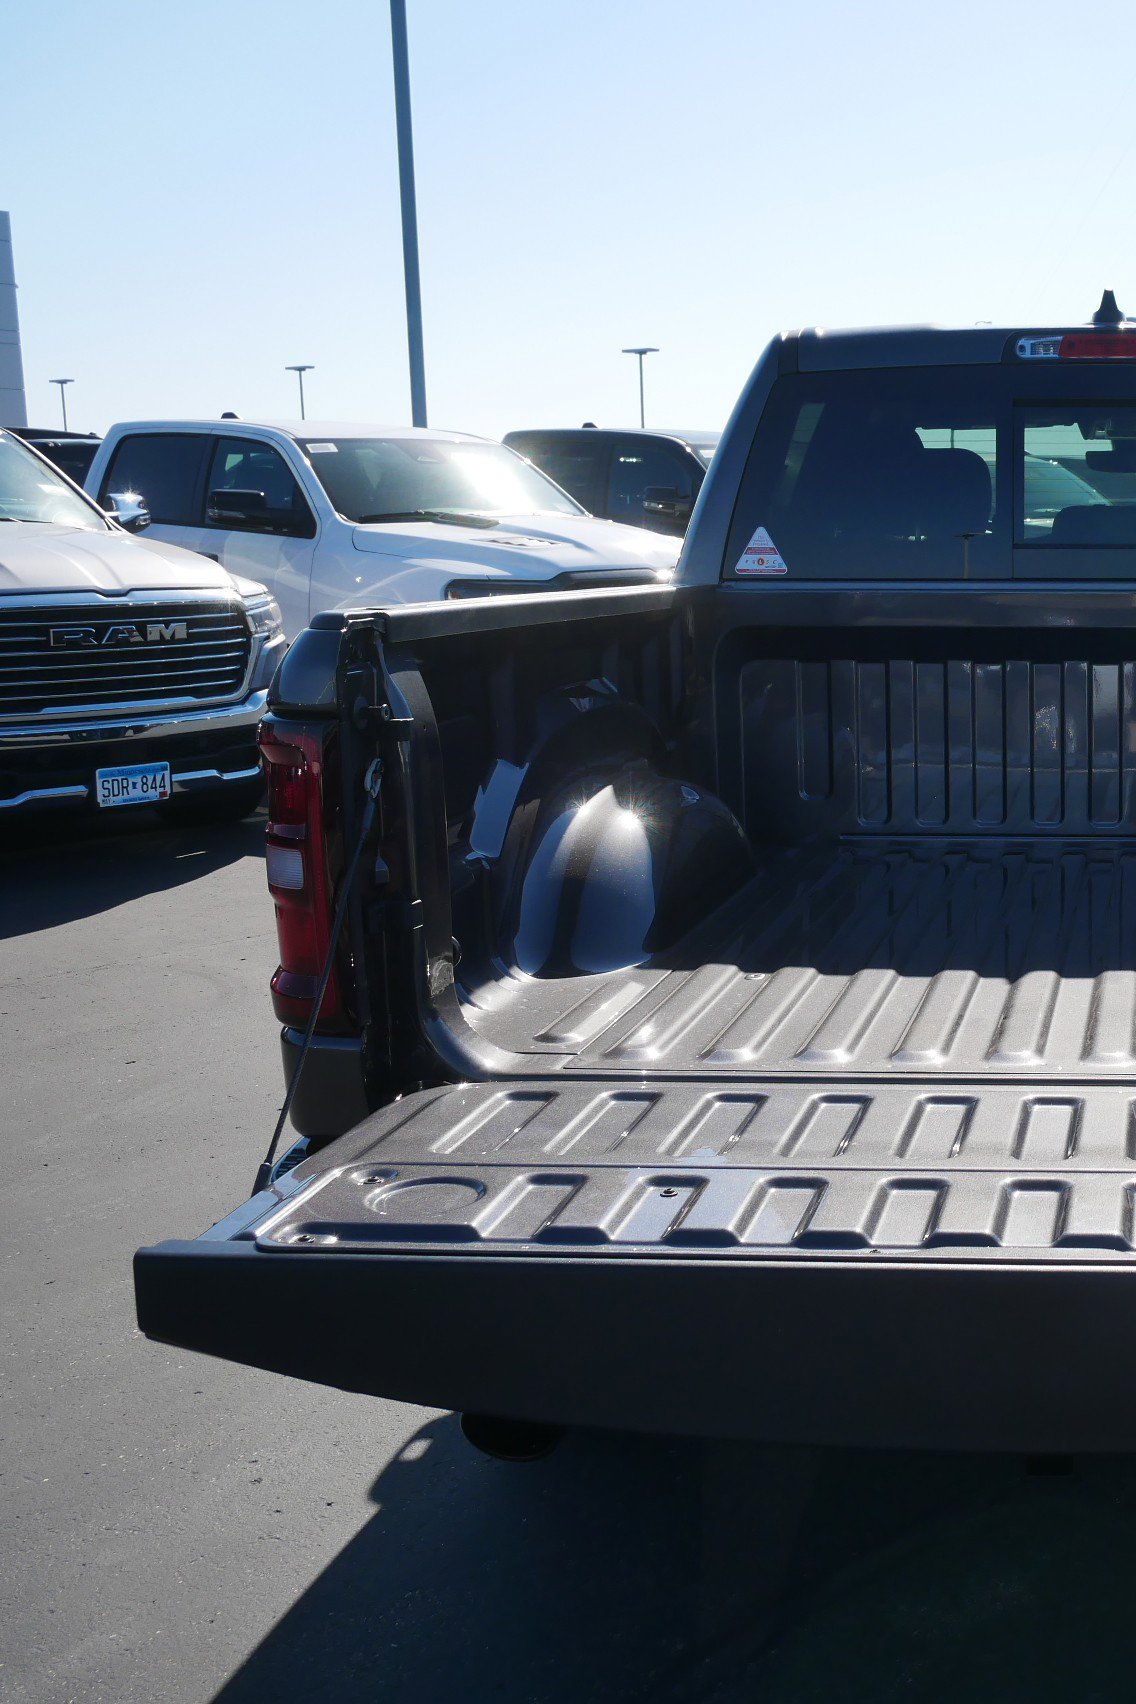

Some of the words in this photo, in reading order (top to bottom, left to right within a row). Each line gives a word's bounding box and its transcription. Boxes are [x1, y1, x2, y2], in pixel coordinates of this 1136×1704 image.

[49, 622, 188, 647] RAM
[101, 777, 130, 798] SDR
[140, 772, 166, 793] 844
